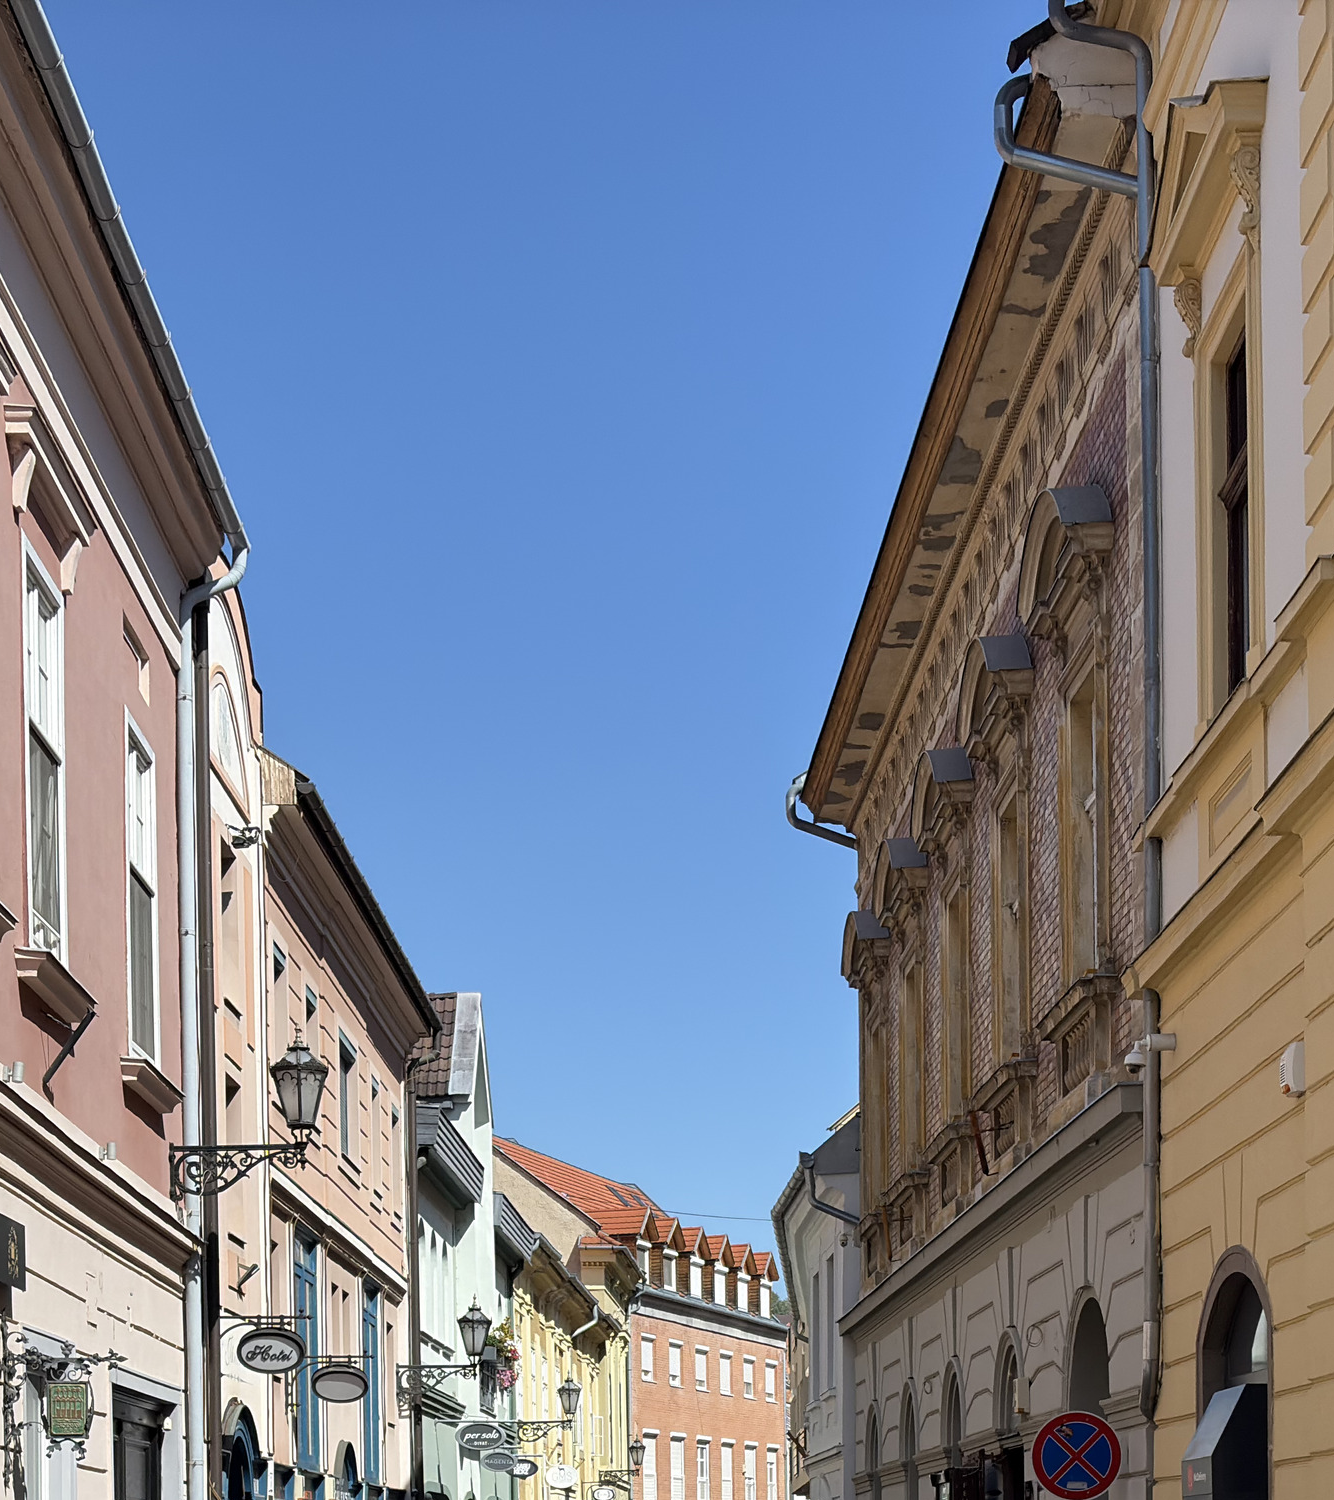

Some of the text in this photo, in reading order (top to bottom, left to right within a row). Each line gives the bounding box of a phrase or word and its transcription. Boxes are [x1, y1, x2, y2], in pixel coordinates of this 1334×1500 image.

[245, 1344, 294, 1363] Hotel
[463, 1429, 500, 1443] per solo
